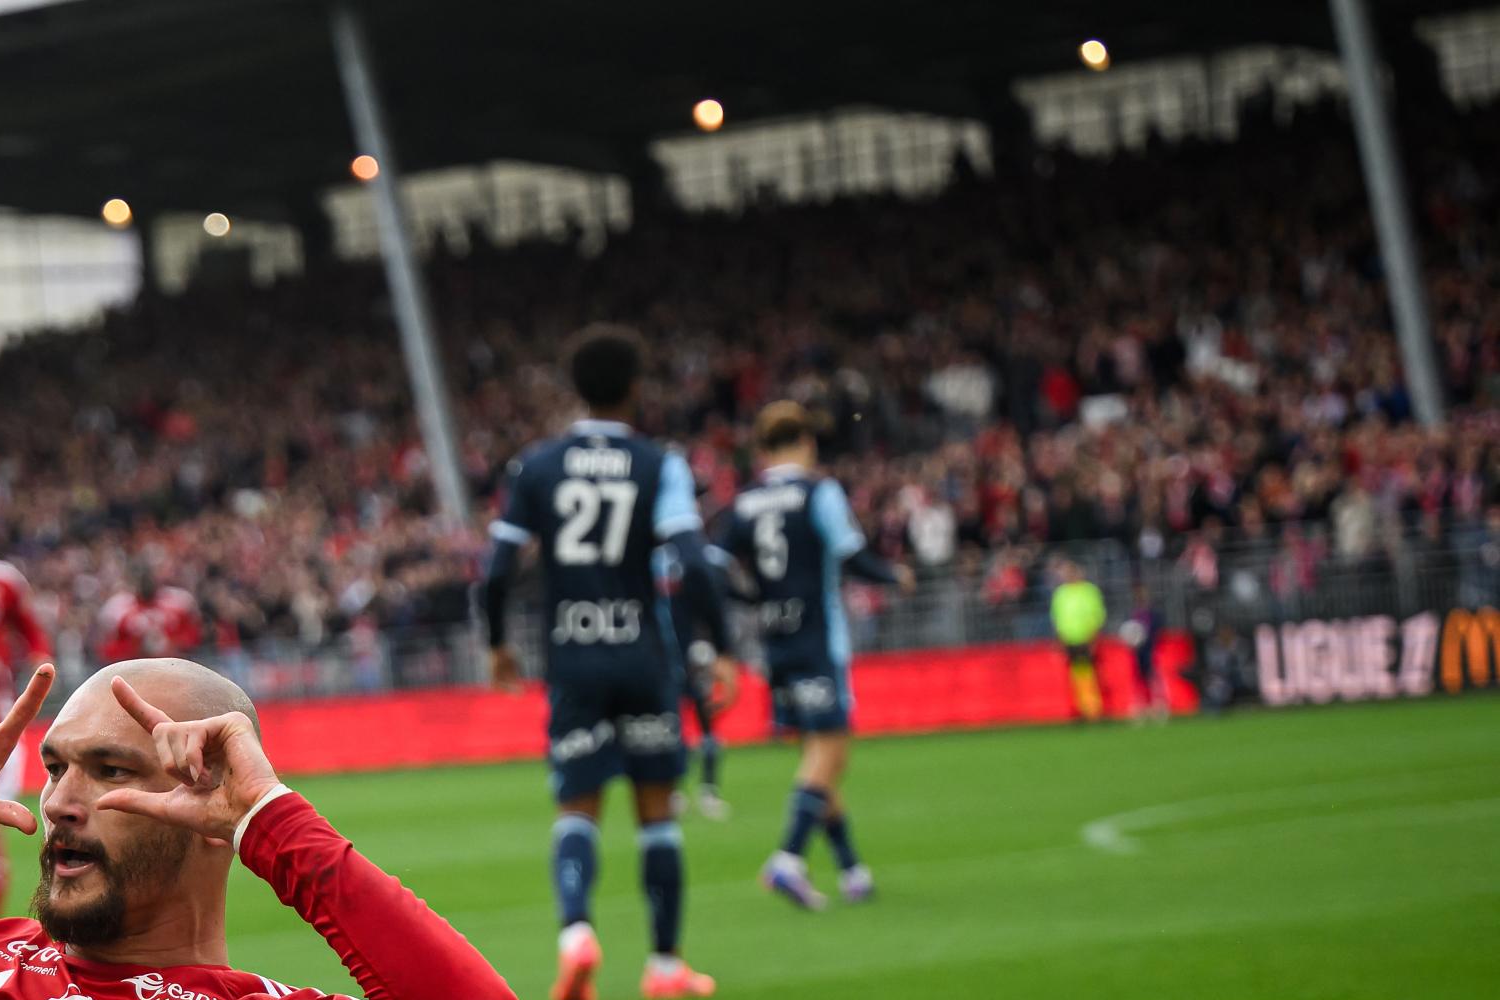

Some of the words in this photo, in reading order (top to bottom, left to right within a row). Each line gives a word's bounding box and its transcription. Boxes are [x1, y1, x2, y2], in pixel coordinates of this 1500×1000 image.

[553, 478, 638, 566] 27
[754, 510, 790, 579] 5
[1255, 612, 1399, 705] LIGUE
